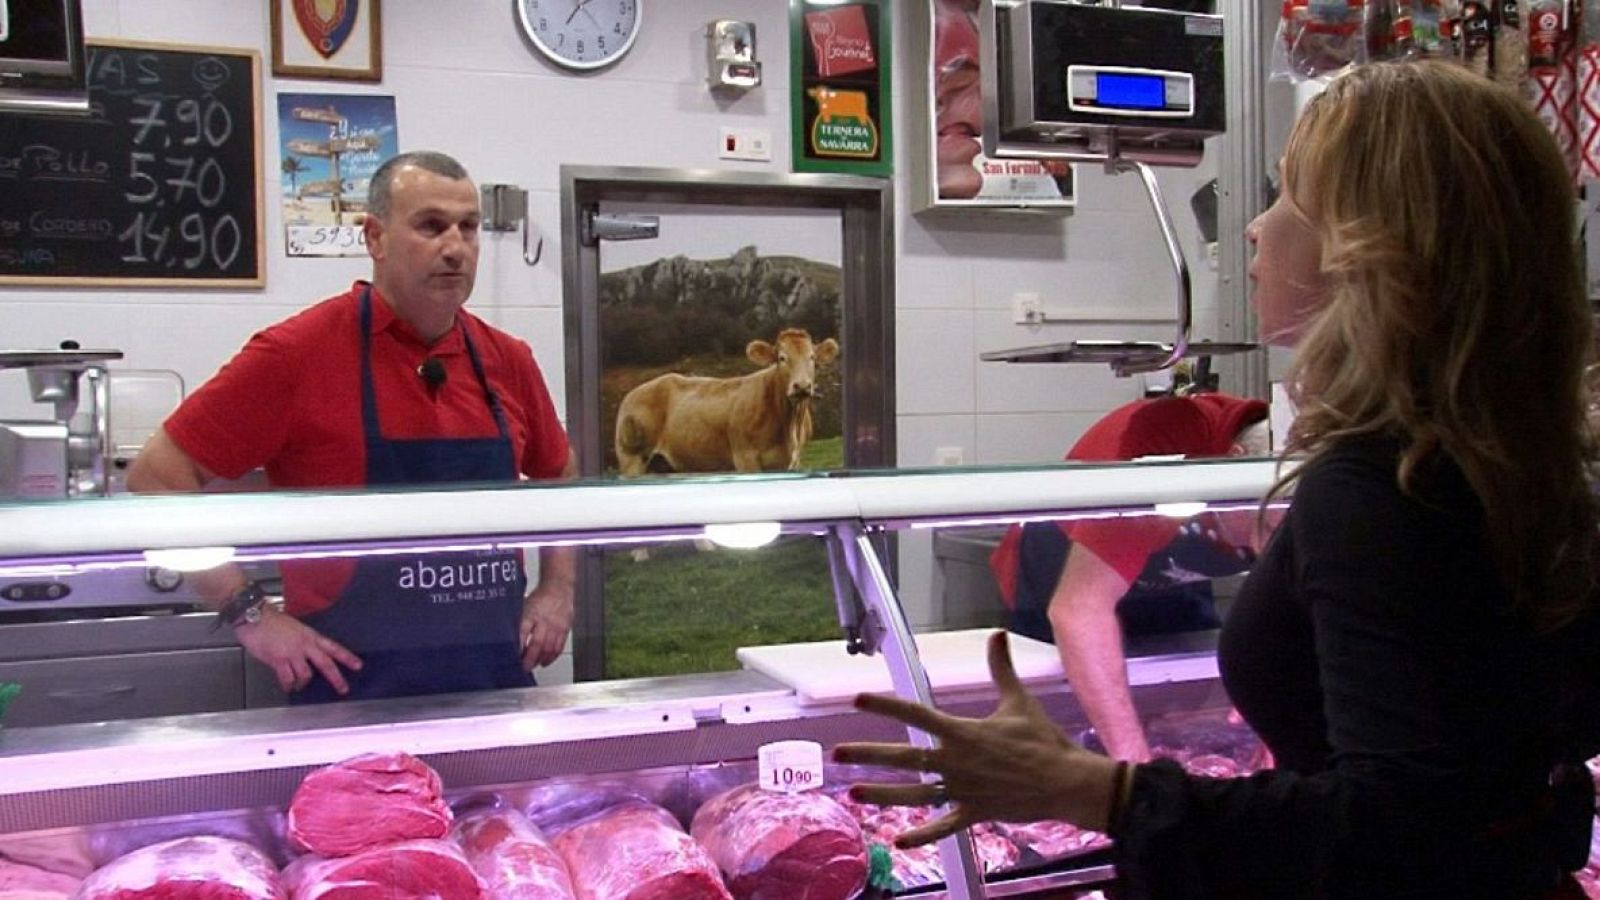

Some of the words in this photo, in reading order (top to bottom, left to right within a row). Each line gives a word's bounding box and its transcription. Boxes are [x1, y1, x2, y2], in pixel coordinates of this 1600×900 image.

[822, 125, 869, 137] TERNERA
[820, 139, 869, 151] NAVARRA
[983, 161, 1003, 174] San
